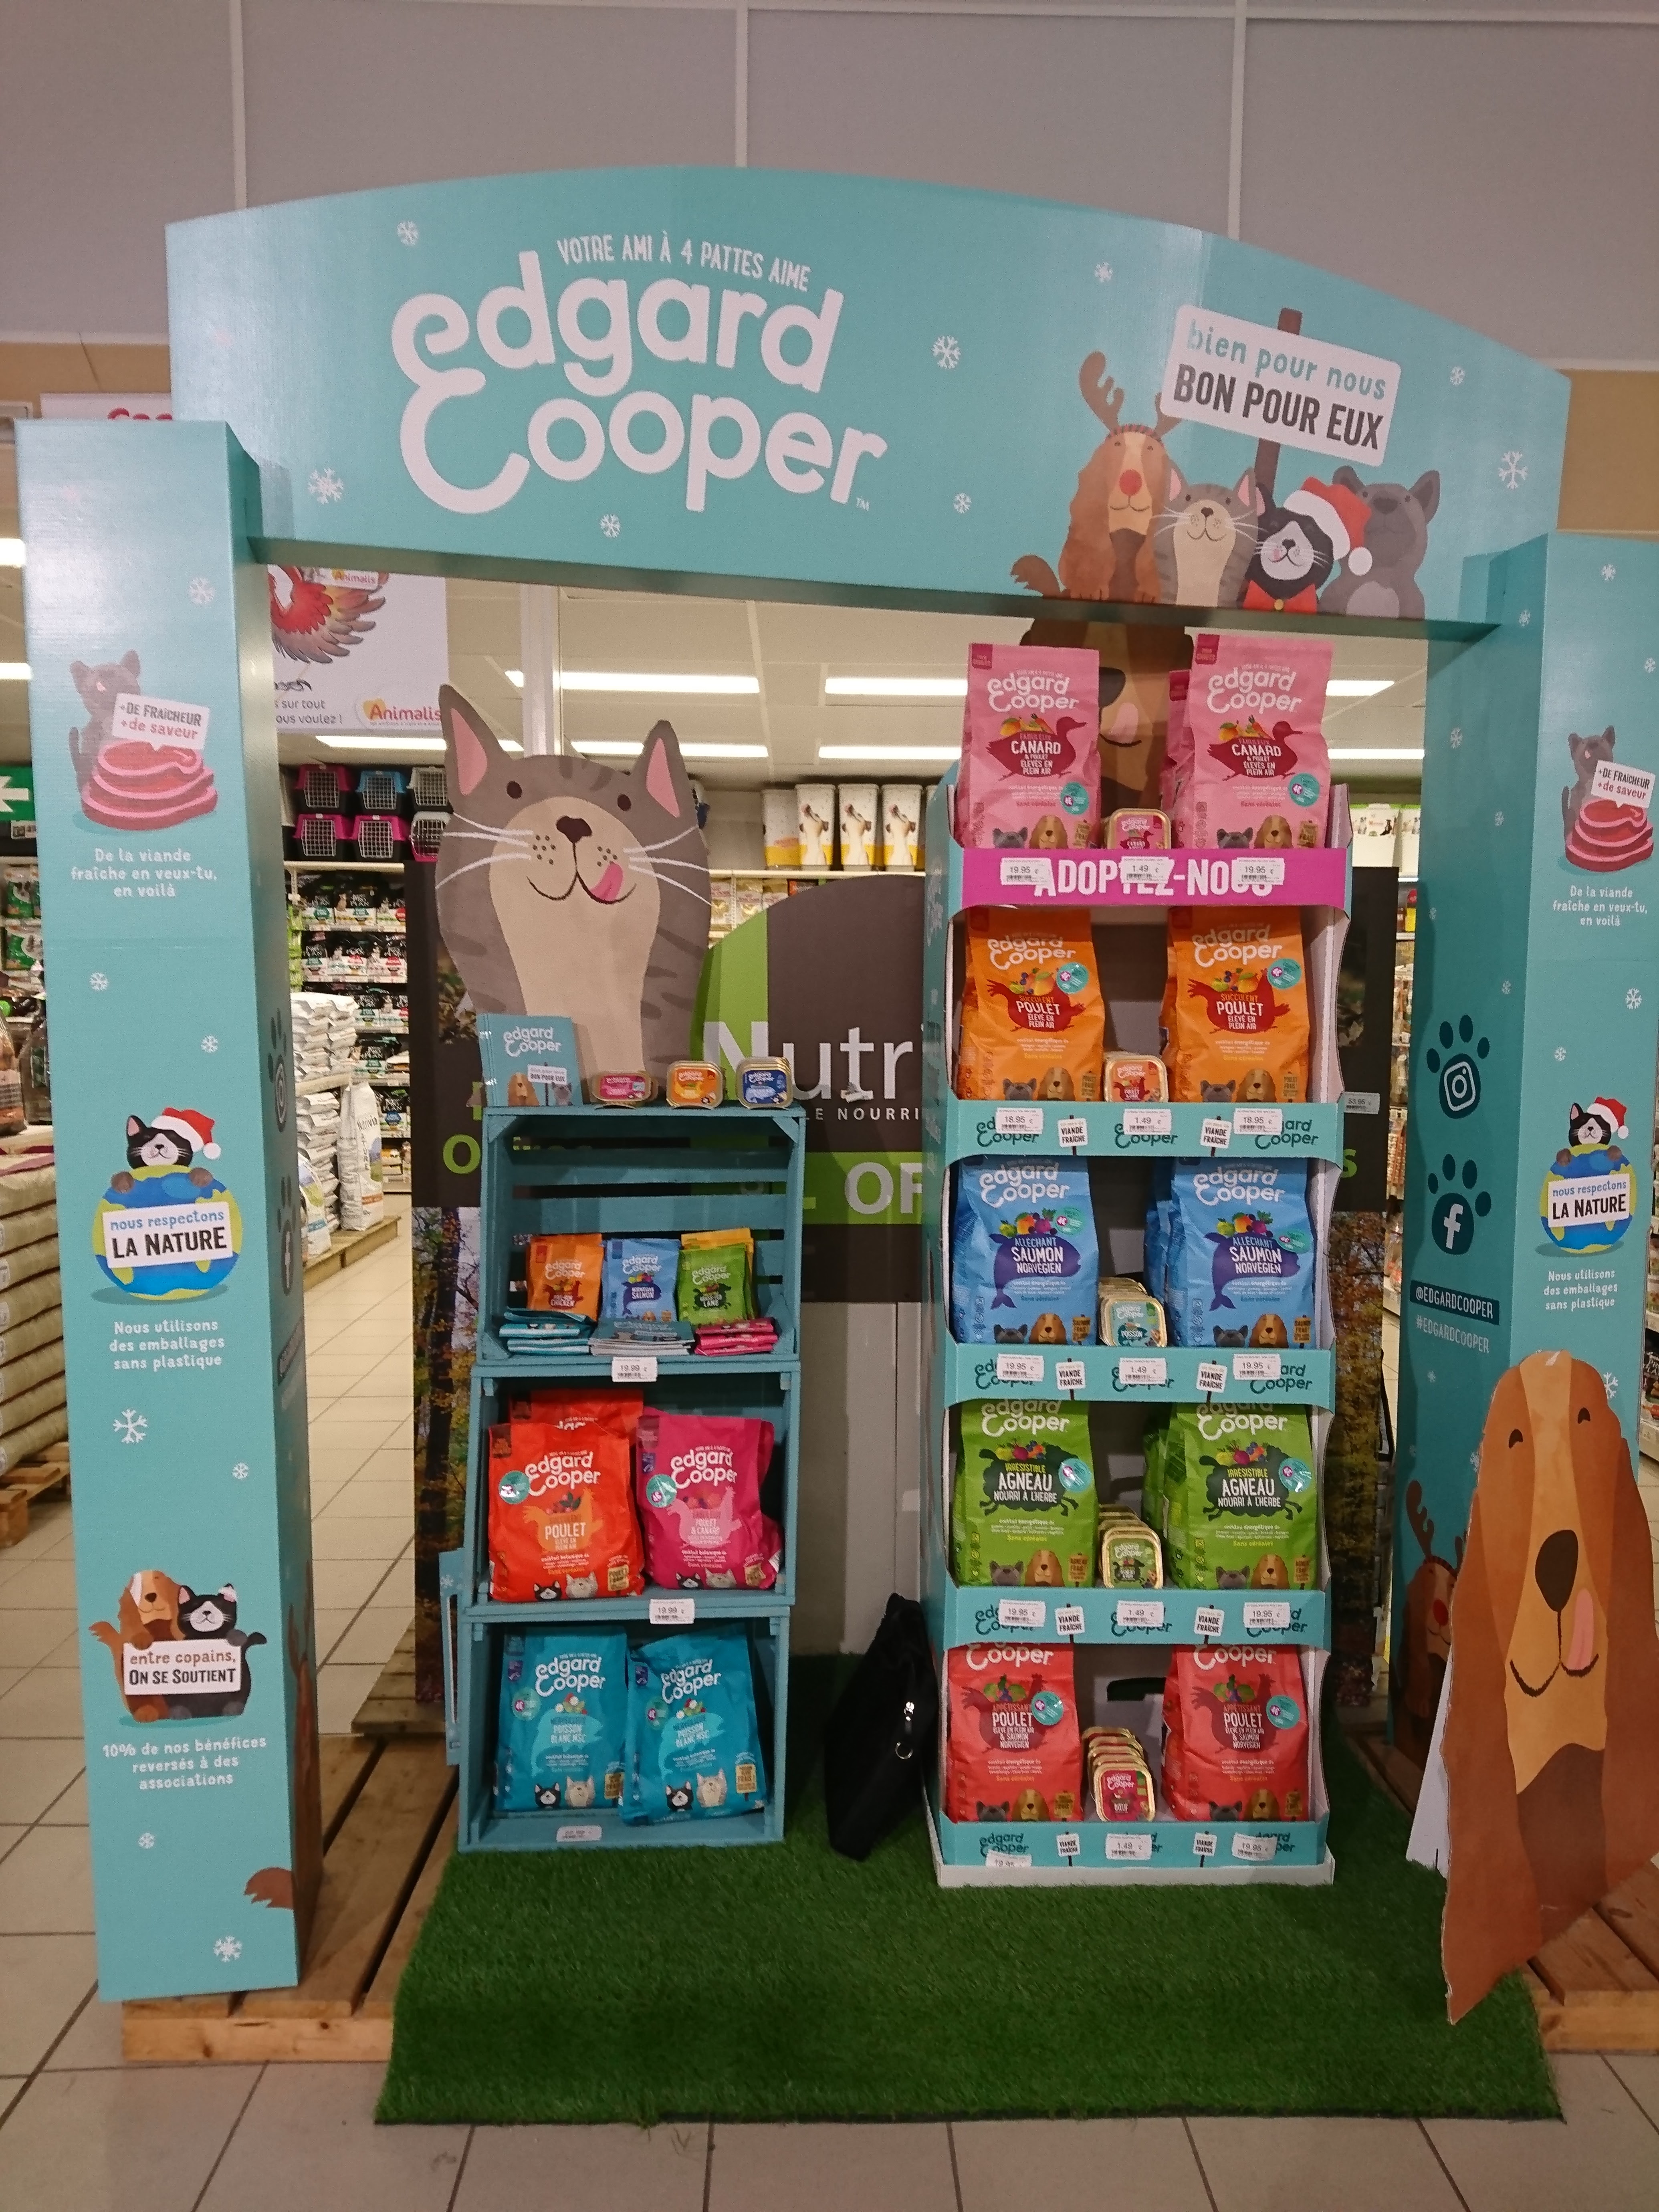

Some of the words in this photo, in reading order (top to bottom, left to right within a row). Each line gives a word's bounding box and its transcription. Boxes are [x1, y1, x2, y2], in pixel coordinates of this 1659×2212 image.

[557, 234, 615, 265] VOTRE
[622, 234, 652, 262] AMI
[660, 230, 671, 262] À
[681, 238, 692, 264] 4
[700, 240, 763, 279] PATTES
[769, 257, 811, 292] AIME
[391, 250, 844, 396] edgard
[1188, 319, 1246, 364] bien
[1255, 349, 1318, 381] pour
[1326, 366, 1387, 401] nous
[1173, 363, 1236, 414] BON
[1242, 381, 1320, 435] POUR
[1326, 403, 1383, 450] EUX
[399, 367, 888, 514] Cooper
[987, 672, 1070, 696] edgard
[1208, 666, 1297, 693] edgard
[282, 701, 299, 709] sur
[302, 700, 325, 710] tout
[989, 690, 1079, 713] Cooper
[1207, 688, 1302, 714] Cooper
[276, 716, 295, 724] ous
[299, 714, 336, 724] voulez
[370, 704, 441, 721] Animalis
[150, 723, 198, 740] saveur
[1011, 740, 1061, 755] CANARD
[1231, 744, 1282, 757] CANARD
[1616, 785, 1647, 800] saveur
[94, 848, 113, 862] De
[119, 848, 134, 862] la
[139, 848, 191, 862] viande
[71, 867, 125, 881] fraîche
[132, 870, 150, 880] en
[155, 866, 218, 881] veux-tu,
[114, 887, 132, 898] en
[137, 882, 176, 898] voilà
[1570, 885, 1583, 897] De
[1586, 885, 1596, 897] la
[1600, 886, 1633, 898] viande
[1552, 900, 1590, 912] fraîche
[1593, 903, 1605, 912] en
[1609, 901, 1648, 914] veux-tu,
[1580, 916, 1592, 926] en
[1596, 914, 1621, 926] voilà
[988, 935, 1063, 951] edgard
[1192, 924, 1270, 948] edgard
[990, 948, 1076, 970] Cooper
[1195, 943, 1282, 967] Cooper
[1221, 993, 1259, 1003] SUCCULENT
[1016, 1001, 1060, 1015] POULET
[1216, 1001, 1263, 1016] POULET
[503, 1026, 554, 1043] edgard
[505, 1040, 561, 1058] Cooper
[703, 1021, 913, 1100] Nutr
[1061, 1126, 1083, 1135] VIANDE
[1205, 1126, 1227, 1136] VIANDE
[979, 1160, 1059, 1187] edgard
[1193, 1167, 1278, 1189] edgard
[980, 1183, 1070, 1208] Cooper
[1195, 1185, 1286, 1206] Cooper
[1552, 1187, 1574, 1197] nous
[1578, 1180, 1627, 1196] respectons
[1552, 1202, 1569, 1220] LA
[1574, 1193, 1627, 1217] NATURE
[110, 1217, 143, 1231] nous
[148, 1210, 224, 1229] respectons
[112, 1237, 137, 1259] LA
[145, 1227, 227, 1256] NATURE
[1233, 1237, 1273, 1248] ALLÉCHANT
[1011, 1247, 1064, 1263] SAUMON
[1229, 1247, 1282, 1263] SAUMON
[1548, 1270, 1571, 1282] Nous
[1574, 1268, 1615, 1280] utilisons
[1544, 1285, 1560, 1296] des
[1563, 1283, 1618, 1298] emballages
[1416, 1286, 1493, 1319] @EDGARDCOOPER
[1545, 1301, 1568, 1310] sans
[1571, 1298, 1615, 1312] plastique
[114, 1322, 149, 1335] Nous
[155, 1319, 218, 1332] utilisons
[1416, 1314, 1489, 1354] #EDGARDCOOPER
[109, 1339, 134, 1352] des
[139, 1337, 225, 1353] emballages
[114, 1358, 146, 1370] sans
[153, 1354, 222, 1372] plastique
[1059, 1370, 1081, 1378] VIANDE
[1201, 1371, 1223, 1380] VIANDE
[981, 1413, 1070, 1437] Cooper
[1199, 1413, 1288, 1440] Cooper
[525, 1452, 593, 1479] edgard
[529, 1469, 601, 1496] Cooper
[671, 1466, 737, 1489] Cooper
[998, 1472, 1052, 1491] AGNEAU
[994, 1491, 1020, 1501] NOURRI
[1222, 1478, 1275, 1496] AGNEAU
[1218, 1497, 1244, 1507] NOURRI
[545, 1522, 586, 1540] POULET
[1059, 1615, 1080, 1623] VIANDE
[1199, 1615, 1220, 1625] VIANDE
[130, 1651, 170, 1664] entre
[175, 1649, 236, 1667] copains,
[966, 1644, 1054, 1671] Cooper
[1193, 1645, 1276, 1670] Cooper
[129, 1669, 148, 1685] ON
[152, 1669, 169, 1683] SE
[172, 1668, 236, 1684] SOUTIENT
[535, 1657, 602, 1679] edgard
[661, 1659, 713, 1685] edgard
[536, 1675, 605, 1697] Cooper
[662, 1672, 721, 1704] Cooper
[992, 1711, 1033, 1728] POULET
[1224, 1712, 1262, 1728] POULET
[102, 1743, 136, 1758] 10%
[141, 1741, 159, 1755] de
[164, 1743, 189, 1754] nos
[194, 1736, 266, 1752] bénéfices
[133, 1756, 194, 1773] reversés
[200, 1756, 208, 1769] à
[213, 1755, 239, 1767] des
[139, 1774, 234, 1790] associations
